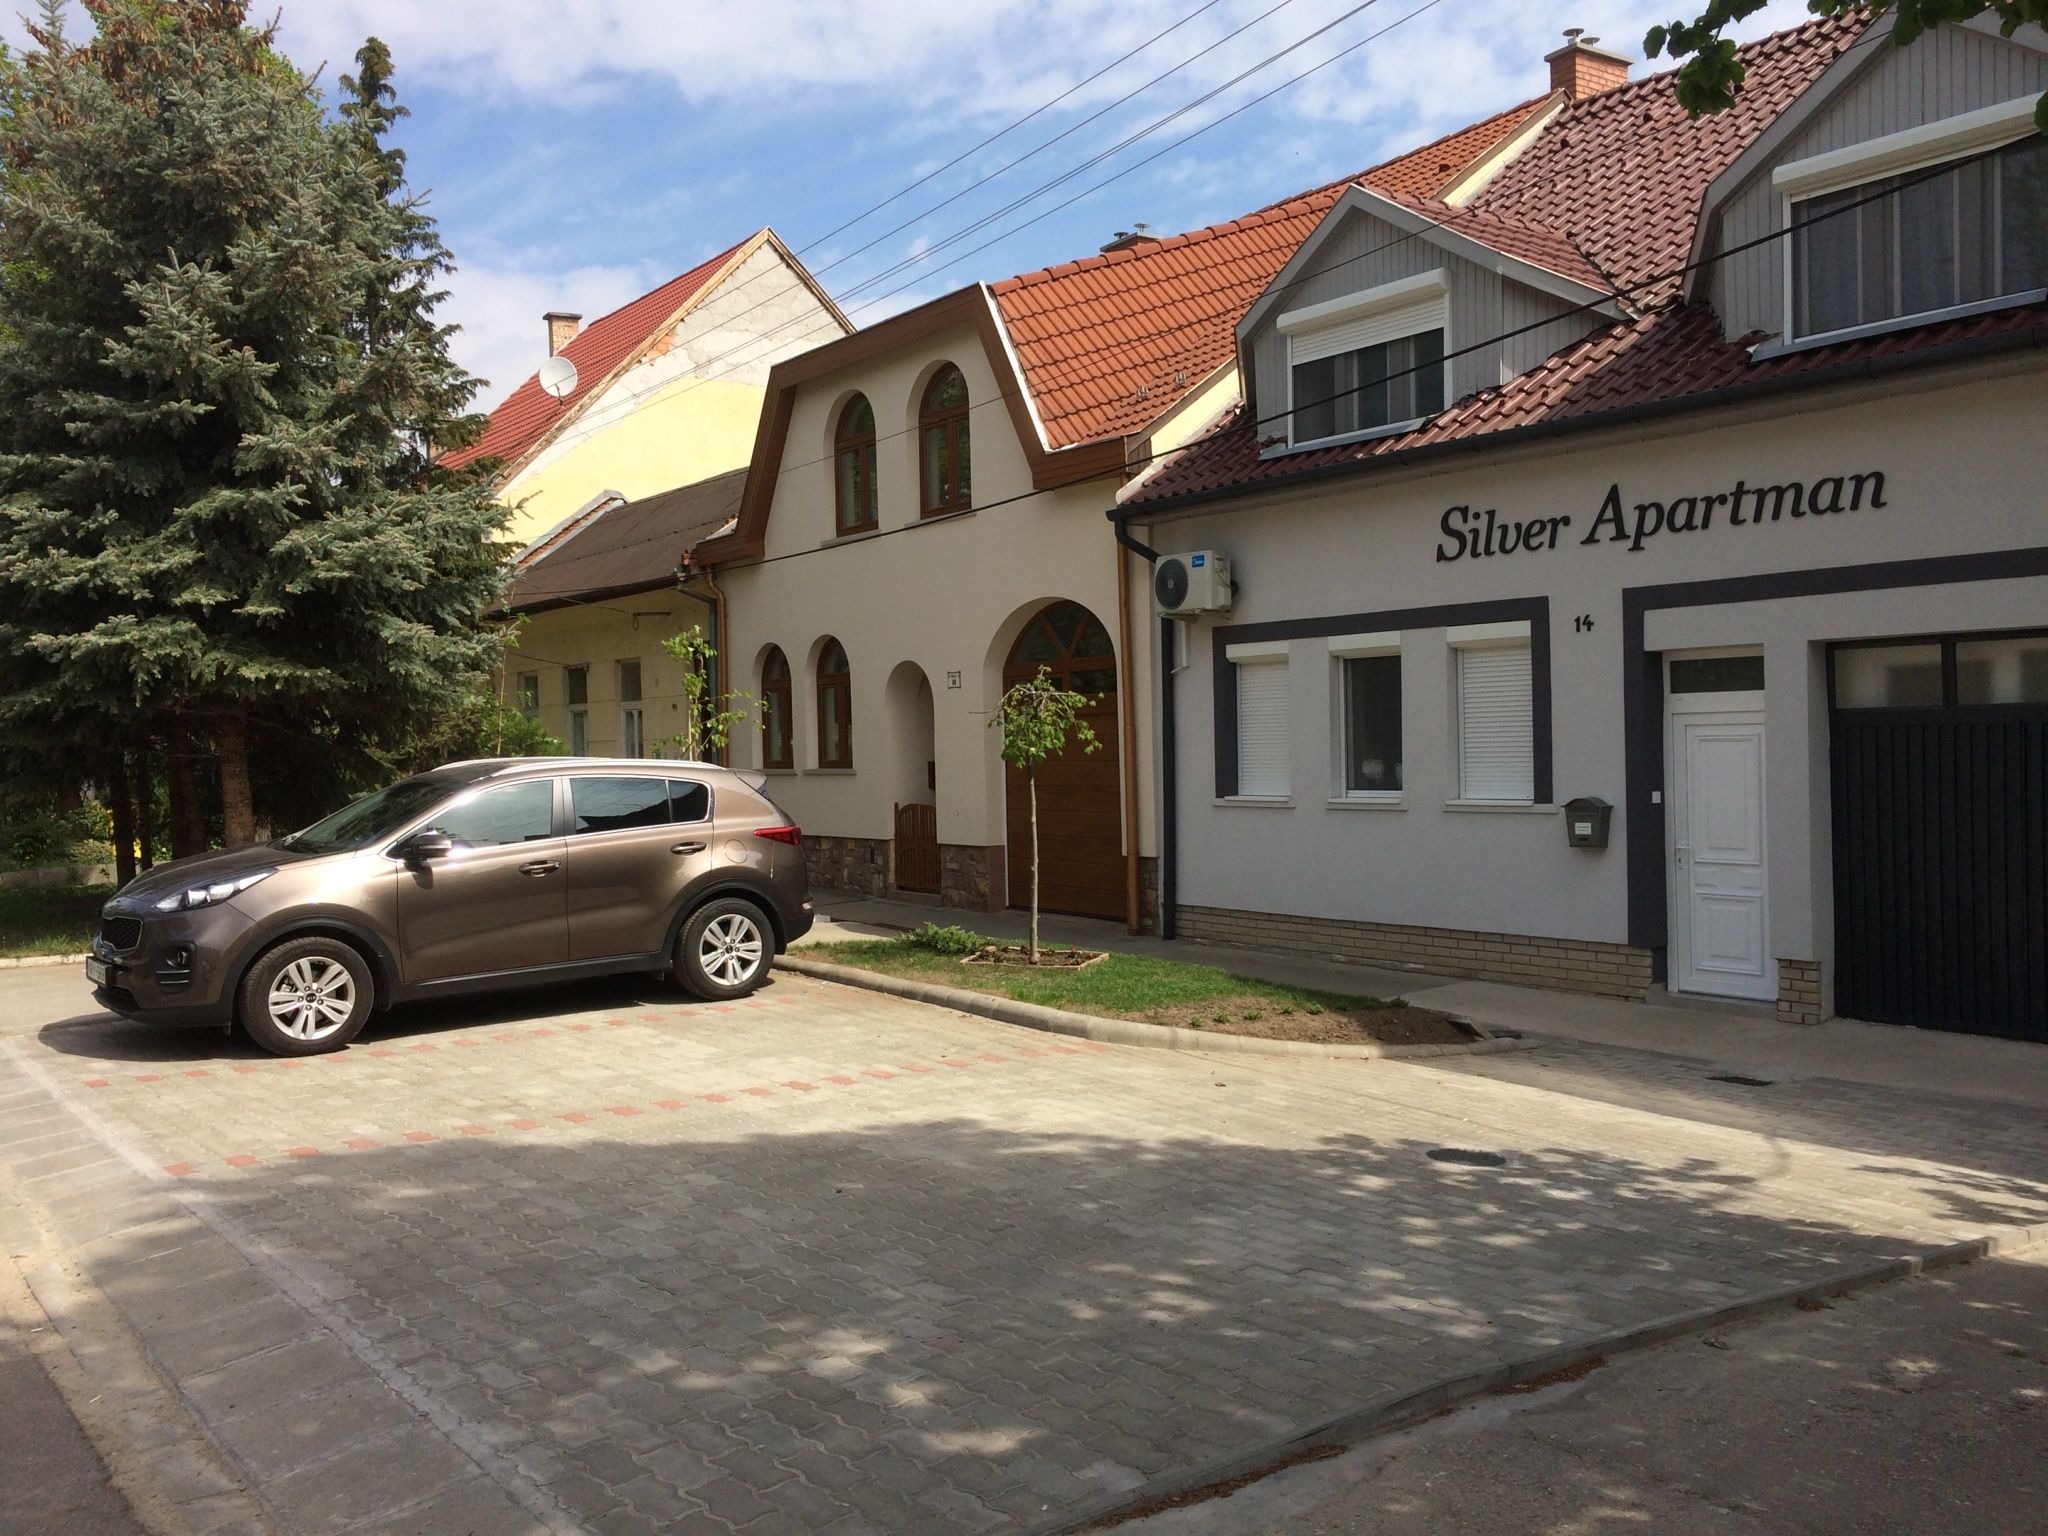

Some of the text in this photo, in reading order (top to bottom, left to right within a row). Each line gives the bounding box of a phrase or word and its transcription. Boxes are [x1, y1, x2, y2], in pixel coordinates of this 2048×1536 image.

[1435, 471, 1888, 563] Silver Apartman
[1574, 614, 1594, 633] 14
